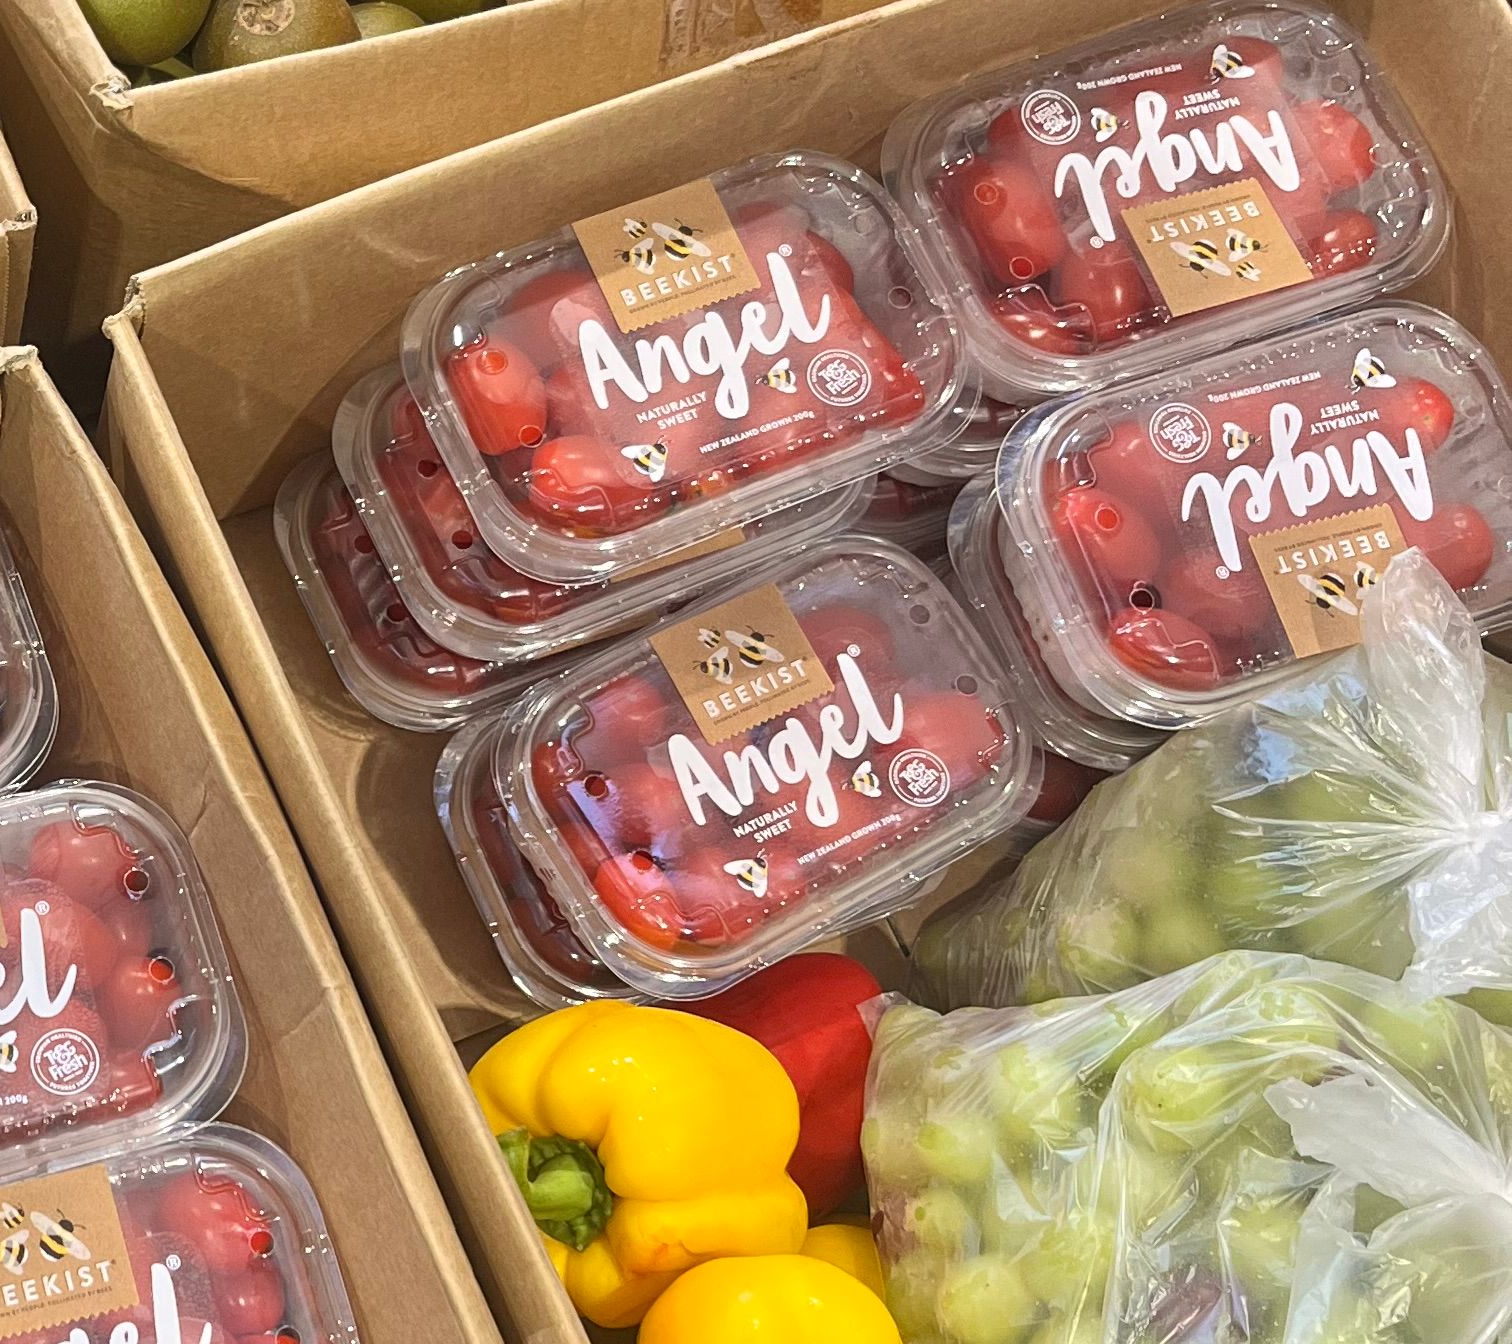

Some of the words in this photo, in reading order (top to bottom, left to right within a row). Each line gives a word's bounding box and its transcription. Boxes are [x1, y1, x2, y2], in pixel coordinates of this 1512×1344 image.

[1125, 68, 1163, 82] ZEALAND
[1163, 64, 1182, 74] NEW
[1173, 95, 1240, 118] NATURALLY
[1181, 87, 1221, 104] SWEET
[1030, 102, 1063, 123] Fresh
[1054, 91, 1299, 241] Angel
[1145, 204, 1260, 244] BEEKIST
[619, 254, 735, 306] BEEKIST
[578, 252, 830, 418] Angel
[825, 369, 860, 394] Fresh
[1261, 376, 1301, 391] ZEALAND
[1301, 372, 1321, 383] NEW
[1206, 392, 1229, 404] 200g
[1228, 385, 1262, 399] GROWN
[636, 390, 708, 423] NATURALLY
[657, 408, 699, 430] SWEET
[1318, 399, 1359, 418] SWEET
[698, 440, 719, 453] NEW
[718, 427, 760, 446] ZEALAND
[758, 415, 792, 432] GROWN
[791, 408, 815, 421] 200g
[1158, 415, 1193, 439] Fresh
[1308, 408, 1379, 434] NATURALLY
[1181, 403, 1432, 571] Angel
[1273, 530, 1389, 574] BEEKIST
[702, 658, 808, 718] BEEKIST
[668, 653, 903, 826] Angel
[907, 768, 939, 795] Fresh
[733, 800, 799, 838] NATURALLY
[753, 818, 792, 843] SWEET
[796, 850, 815, 864] NEW
[814, 833, 852, 856] ZEALAND
[849, 819, 881, 839] GROWN
[48, 1053, 87, 1081] Fresh
[4, 1093, 28, 1106] 200g
